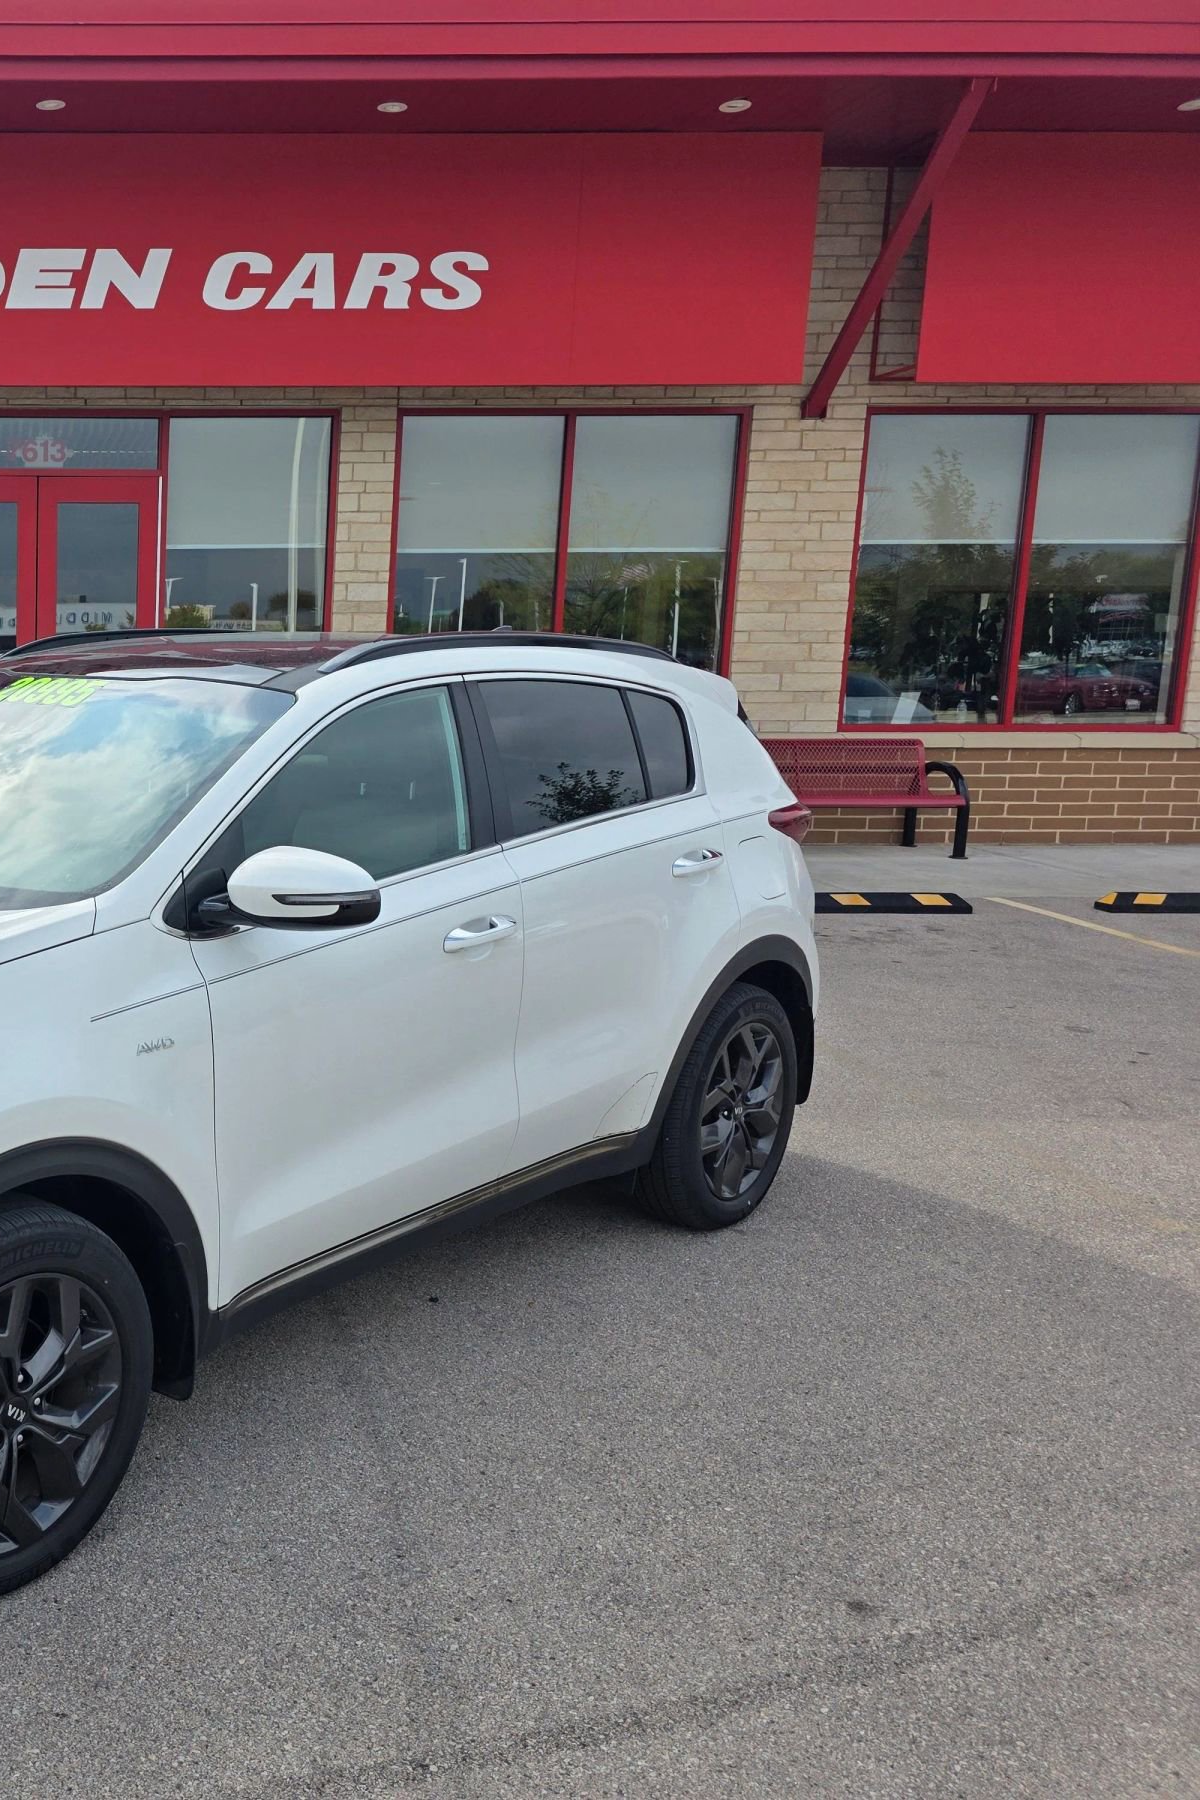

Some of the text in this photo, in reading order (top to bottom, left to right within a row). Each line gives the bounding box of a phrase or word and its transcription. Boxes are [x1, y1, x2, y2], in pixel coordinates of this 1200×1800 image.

[201, 250, 489, 311] CARS
[136, 1038, 175, 1056] AWD
[7, 1404, 26, 1422] KIA
